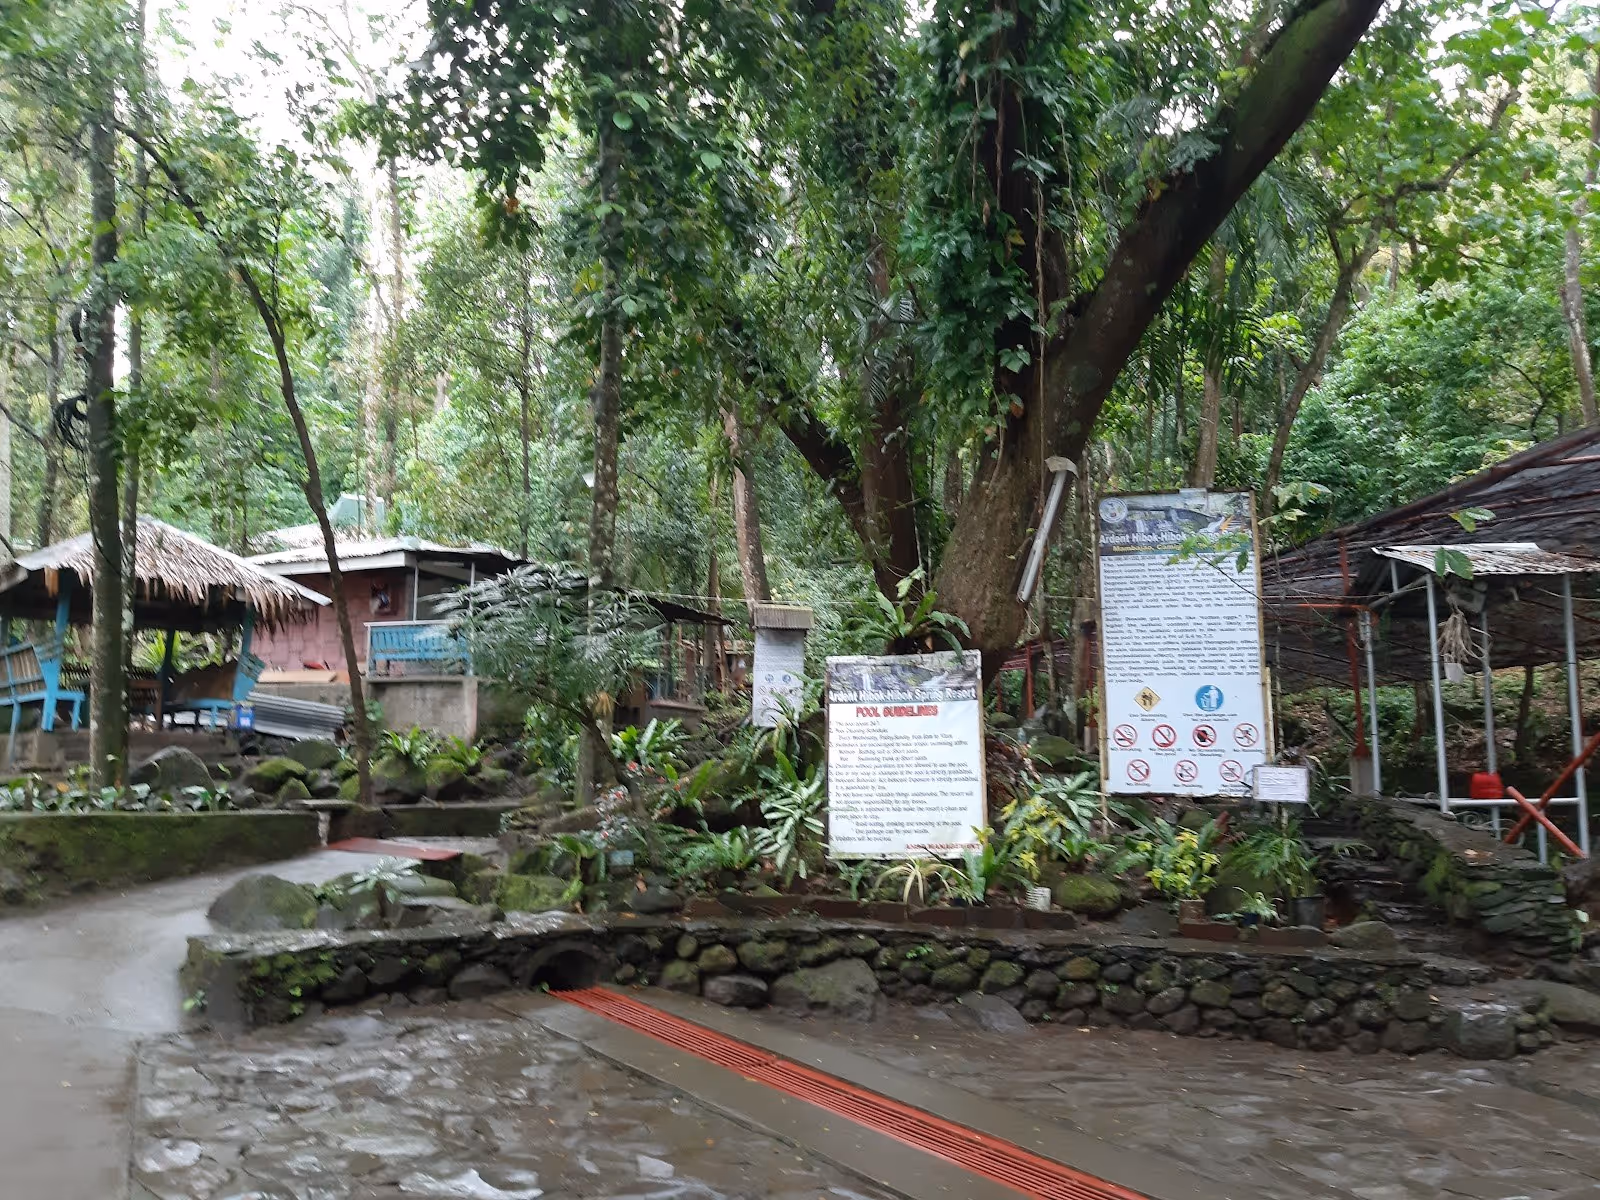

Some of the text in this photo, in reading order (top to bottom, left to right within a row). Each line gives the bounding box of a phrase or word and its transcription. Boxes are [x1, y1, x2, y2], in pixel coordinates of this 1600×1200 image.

[1099, 534, 1129, 545] Ardent
[1131, 532, 1187, 544] Hibok-Hibok
[1112, 543, 1154, 553] Mambajao,
[914, 689, 943, 701] Spring
[945, 688, 977, 700] Resort
[856, 705, 938, 717] POOL GUIDELINES
